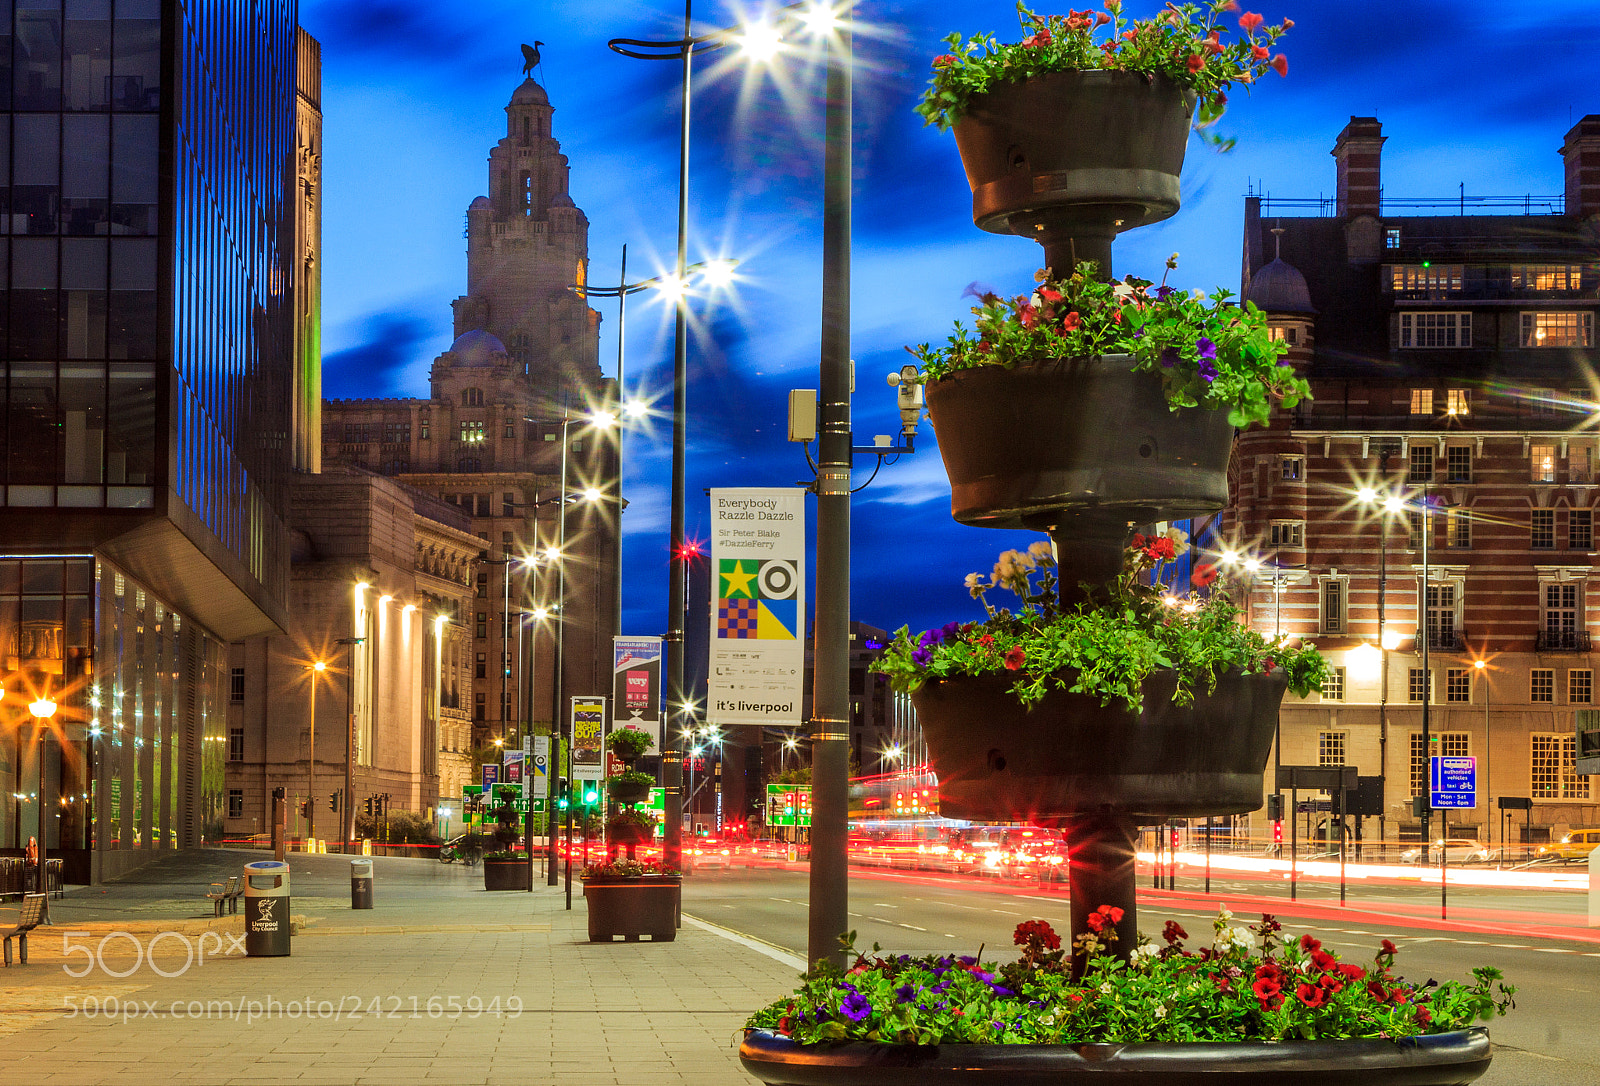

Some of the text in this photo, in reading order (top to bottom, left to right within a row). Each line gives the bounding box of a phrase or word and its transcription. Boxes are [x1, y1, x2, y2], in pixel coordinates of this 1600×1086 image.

[718, 498, 778, 510] Everybody
[718, 510, 794, 521] Razzle Dazzle
[718, 529, 781, 538] Sir Peter Blake
[719, 540, 775, 550] #DazzleFerry
[628, 677, 648, 687] very
[716, 700, 793, 714] it's liverpool
[574, 730, 597, 739] OUT
